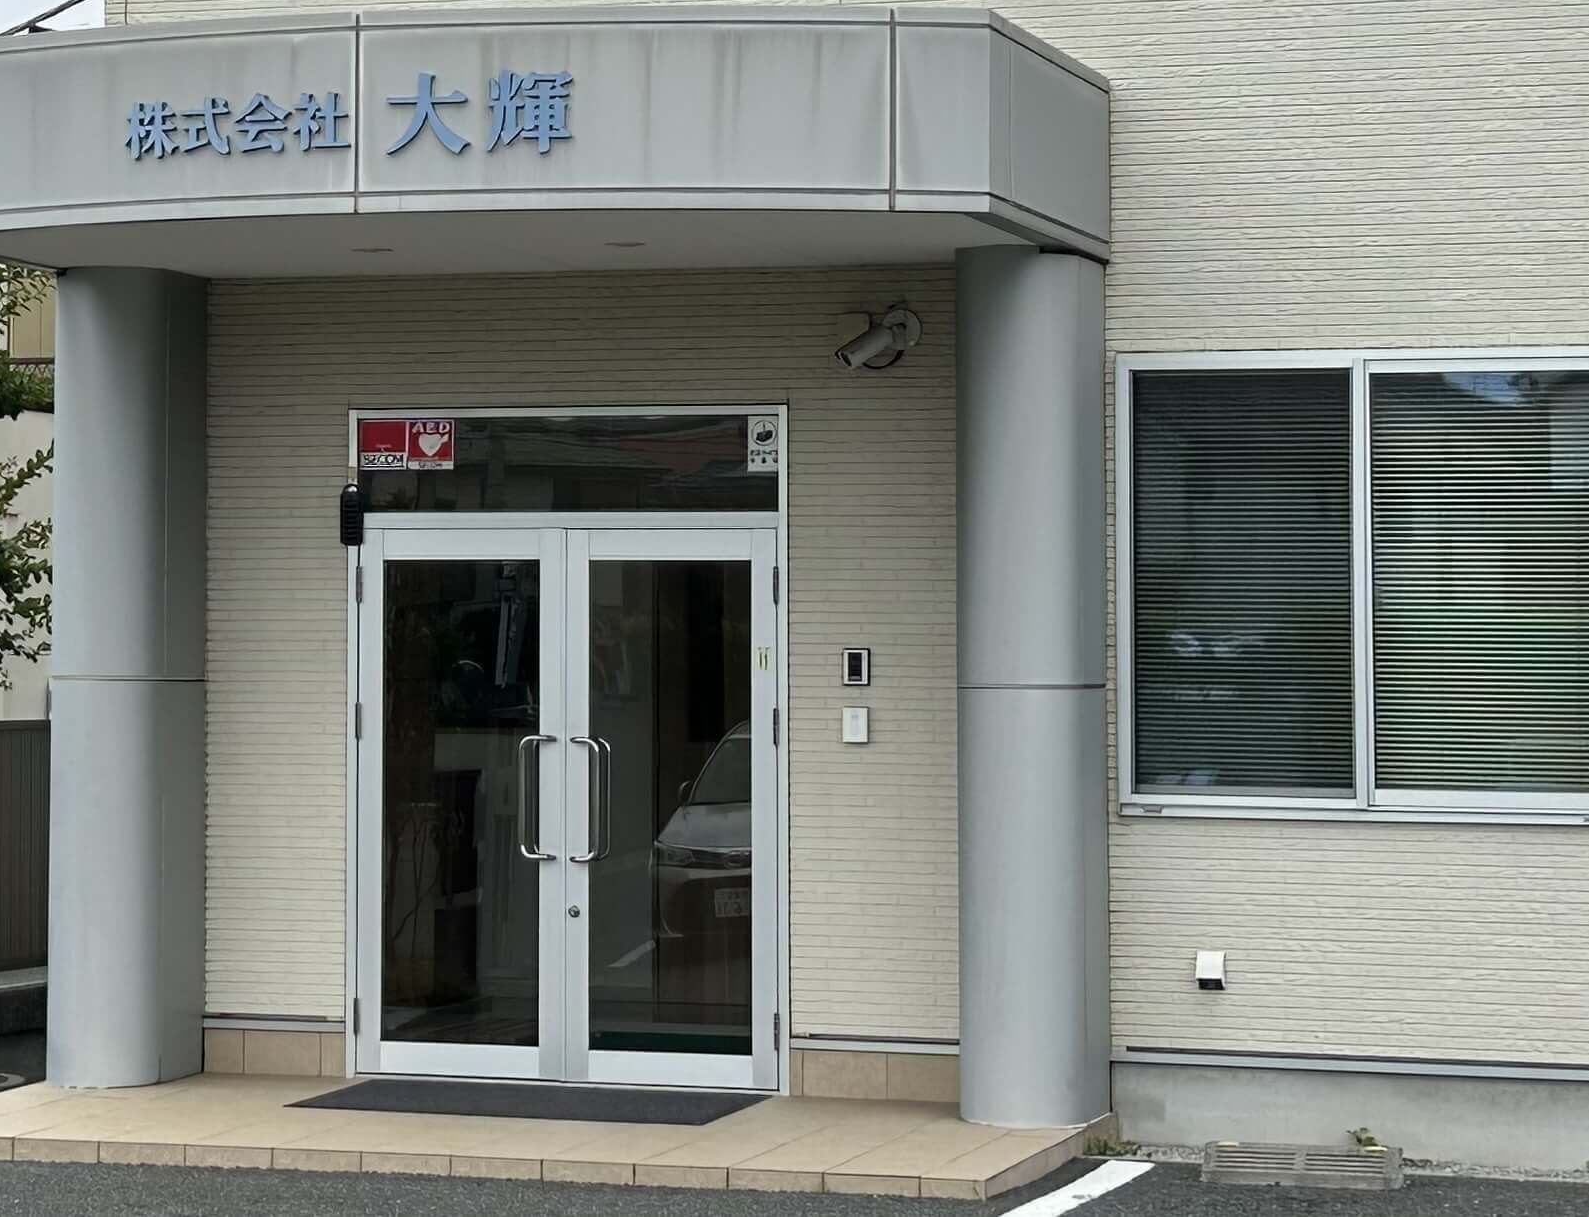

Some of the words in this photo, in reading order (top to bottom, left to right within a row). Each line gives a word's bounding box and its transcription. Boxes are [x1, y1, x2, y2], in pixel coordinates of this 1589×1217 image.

[124, 91, 352, 161] 株式会社
[385, 69, 574, 157] 大輝
[412, 422, 450, 433] AED
